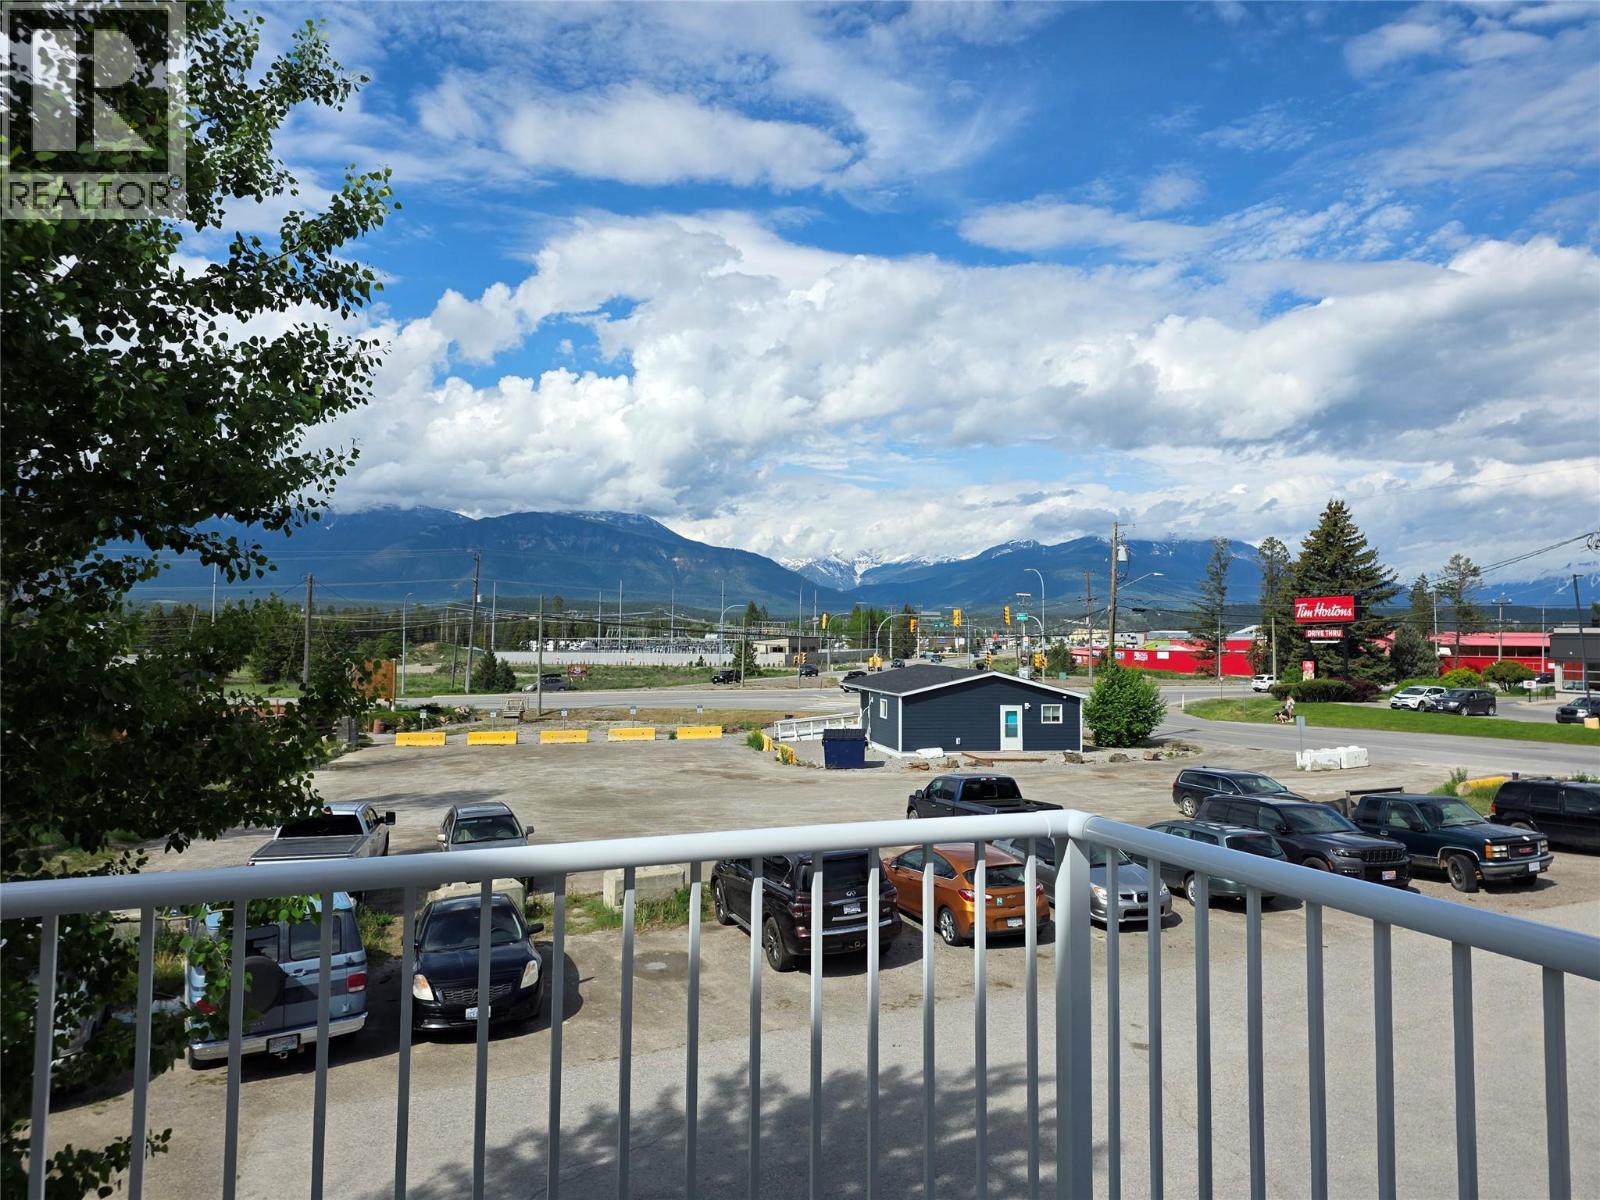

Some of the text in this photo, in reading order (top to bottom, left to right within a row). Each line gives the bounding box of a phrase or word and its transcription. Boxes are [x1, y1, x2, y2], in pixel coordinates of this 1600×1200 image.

[1296, 602, 1352, 618] Tim Hortons
[1307, 629, 1341, 637] DRIVE THRU
